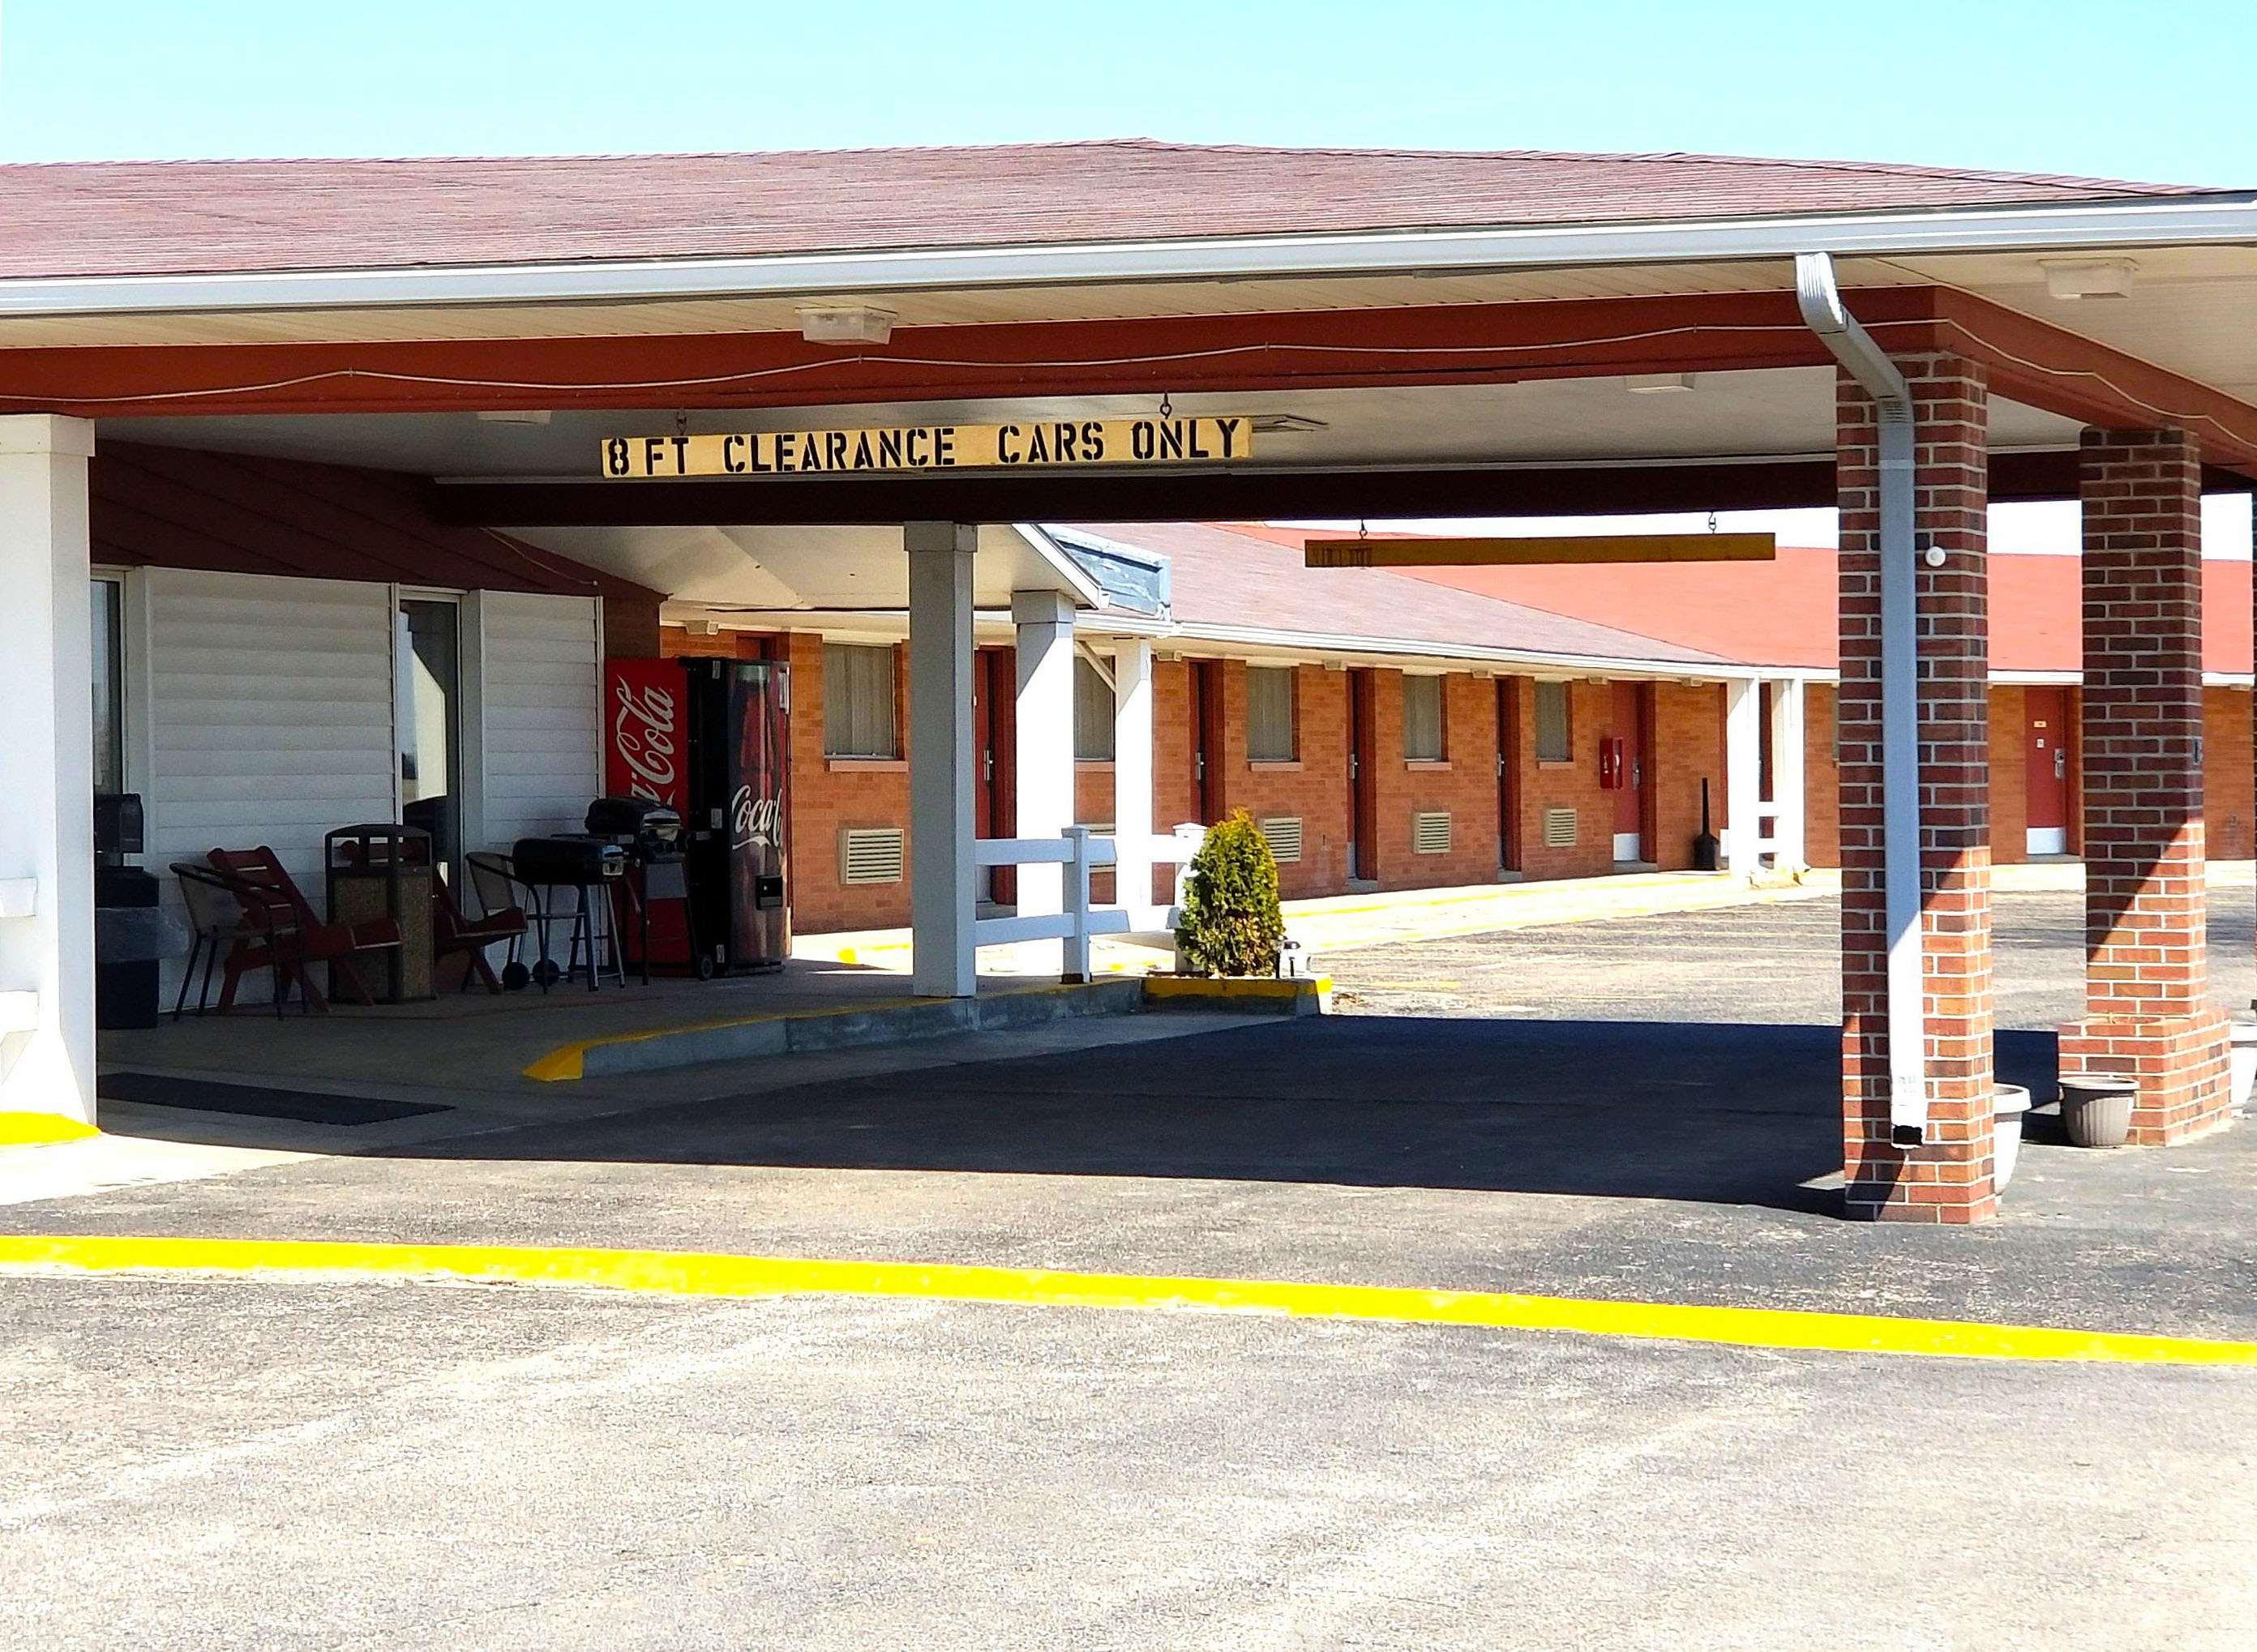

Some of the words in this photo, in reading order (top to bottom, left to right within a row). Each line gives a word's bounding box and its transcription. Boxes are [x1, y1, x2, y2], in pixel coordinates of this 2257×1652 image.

[608, 438, 630, 476] 8
[645, 437, 689, 475] FT
[724, 428, 955, 473] CLEARANCE
[998, 422, 1103, 464] CARS
[1133, 418, 1240, 460] ONLY
